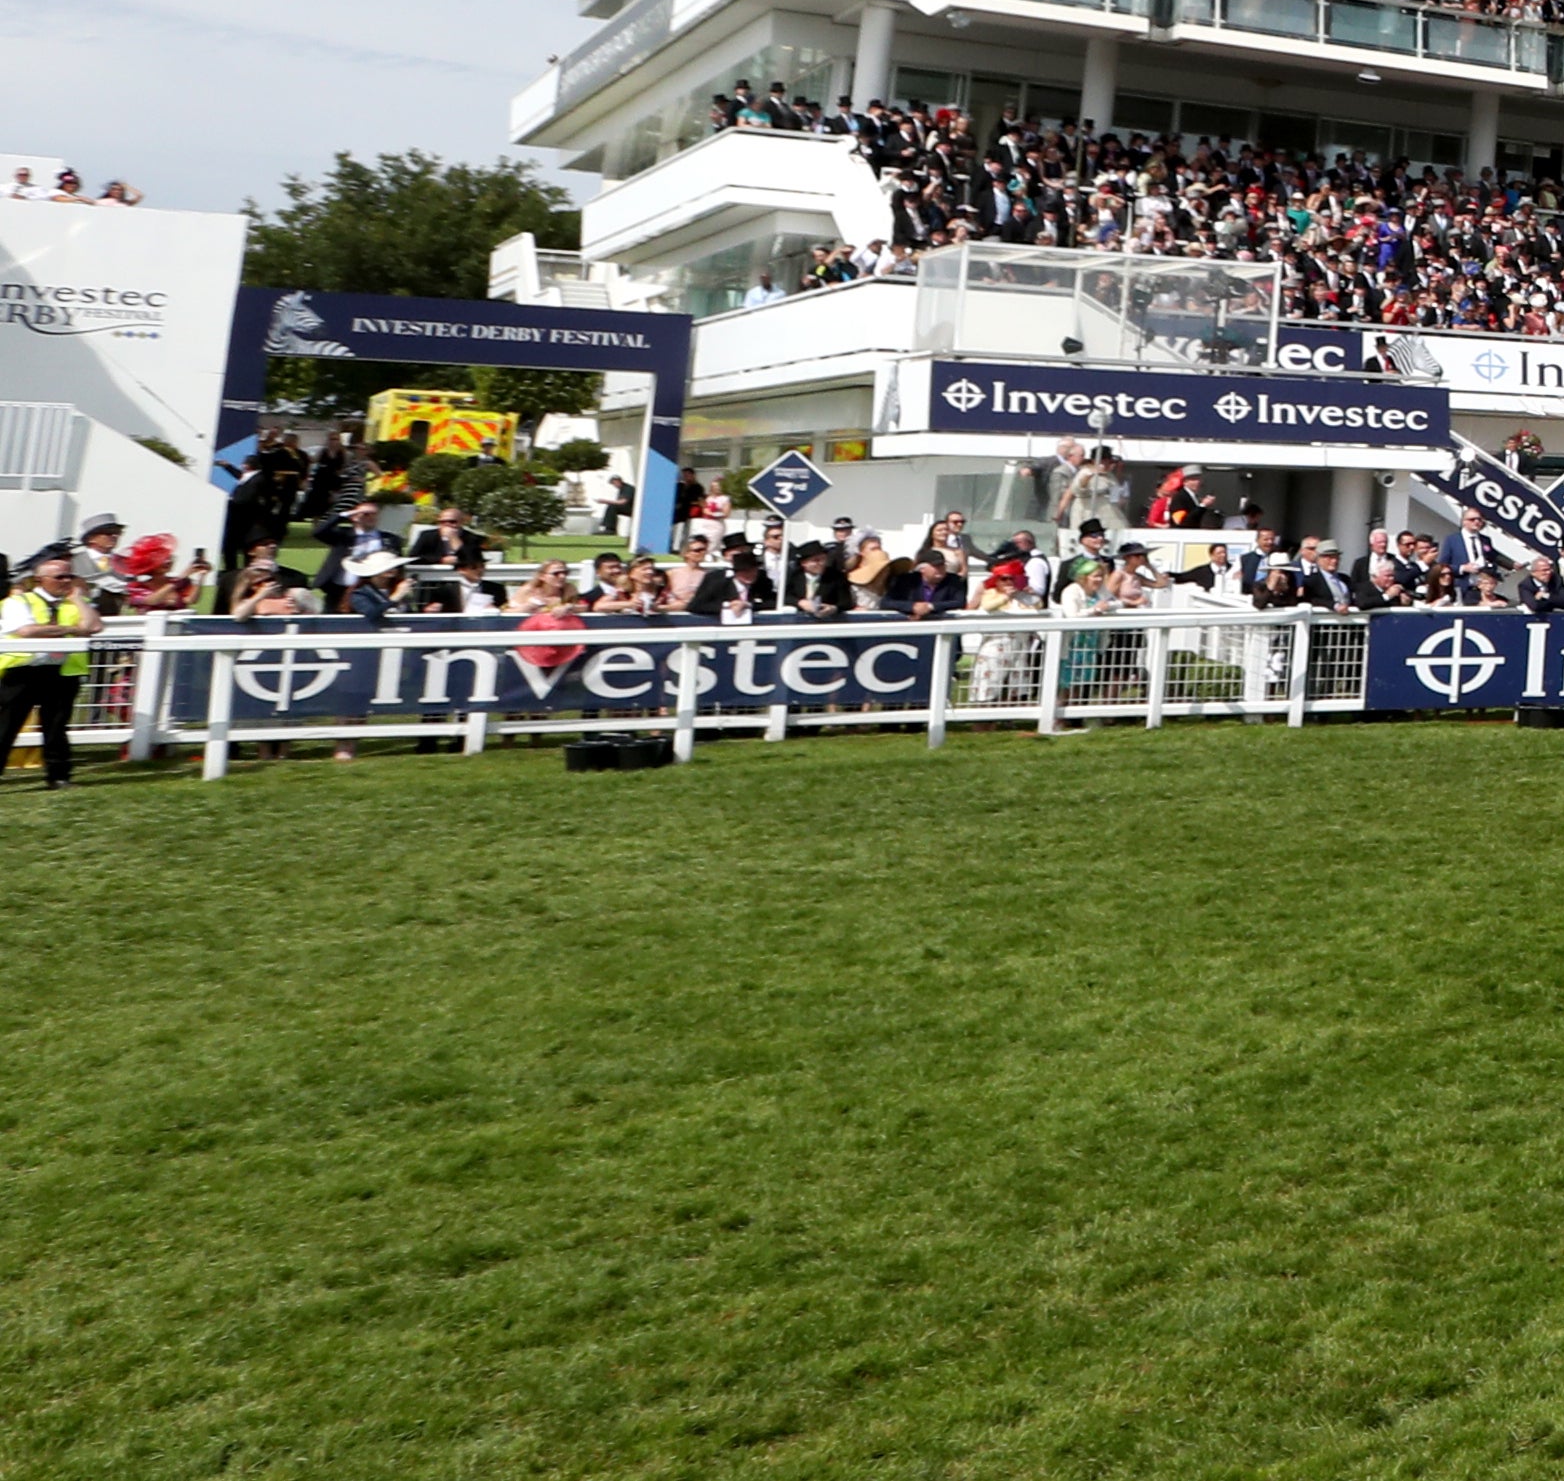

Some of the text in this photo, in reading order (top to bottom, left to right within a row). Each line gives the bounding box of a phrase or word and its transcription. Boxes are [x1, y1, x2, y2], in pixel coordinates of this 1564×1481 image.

[0, 283, 168, 308] nvestec
[0, 303, 74, 326] RBY
[351, 317, 652, 349] INVESTEC DERBY FESTIVAL
[993, 382, 1188, 421] Investec
[1257, 394, 1429, 432] Investec
[369, 628, 920, 704] Investec
